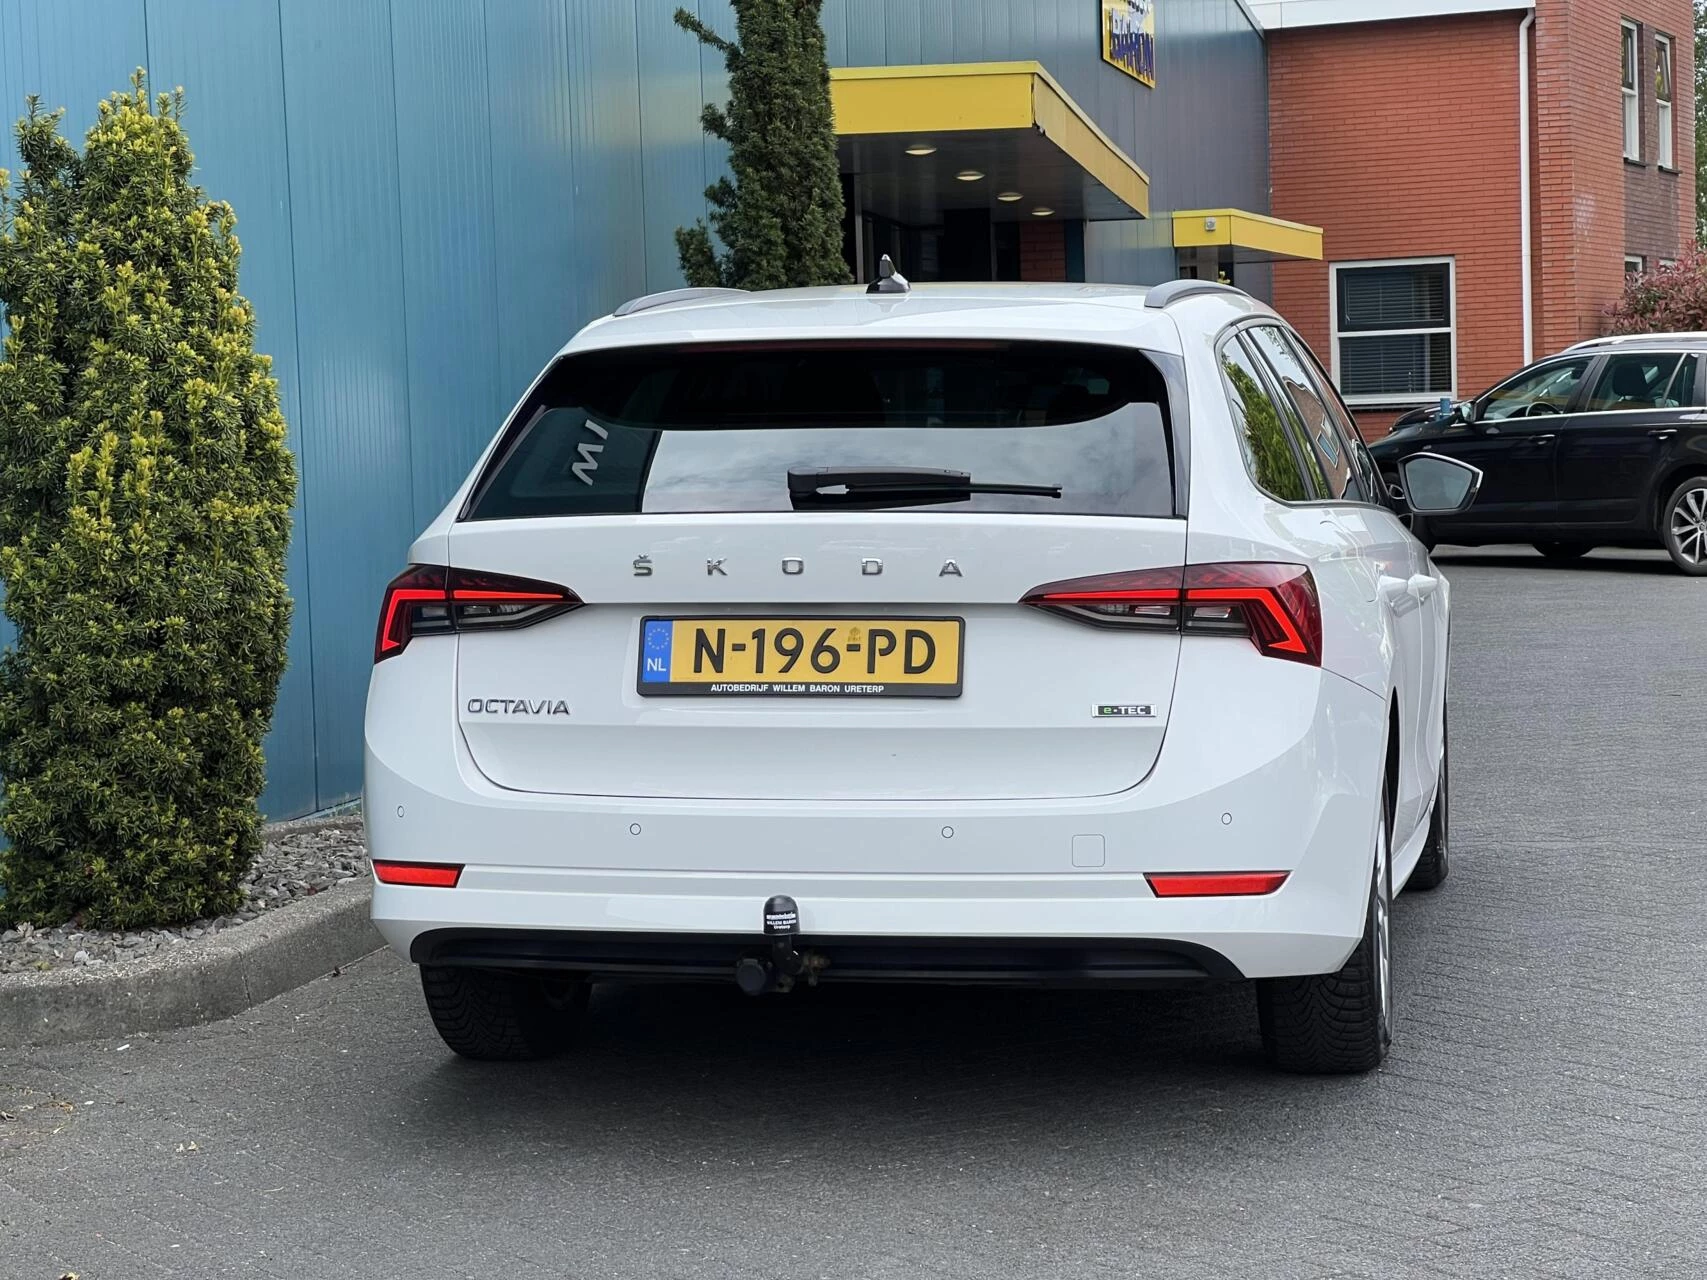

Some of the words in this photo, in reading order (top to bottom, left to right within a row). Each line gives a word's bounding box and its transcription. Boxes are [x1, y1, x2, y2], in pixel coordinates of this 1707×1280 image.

[632, 553, 964, 578] ŠKODA
[693, 627, 937, 675] N-196-PD
[646, 657, 667, 672] NL
[710, 683, 769, 693] AUTOBEDRIJF
[773, 684, 806, 693] WILLEM
[809, 685, 841, 694] BARON
[844, 685, 885, 694] URETERP
[467, 698, 570, 716] OCTAVIA
